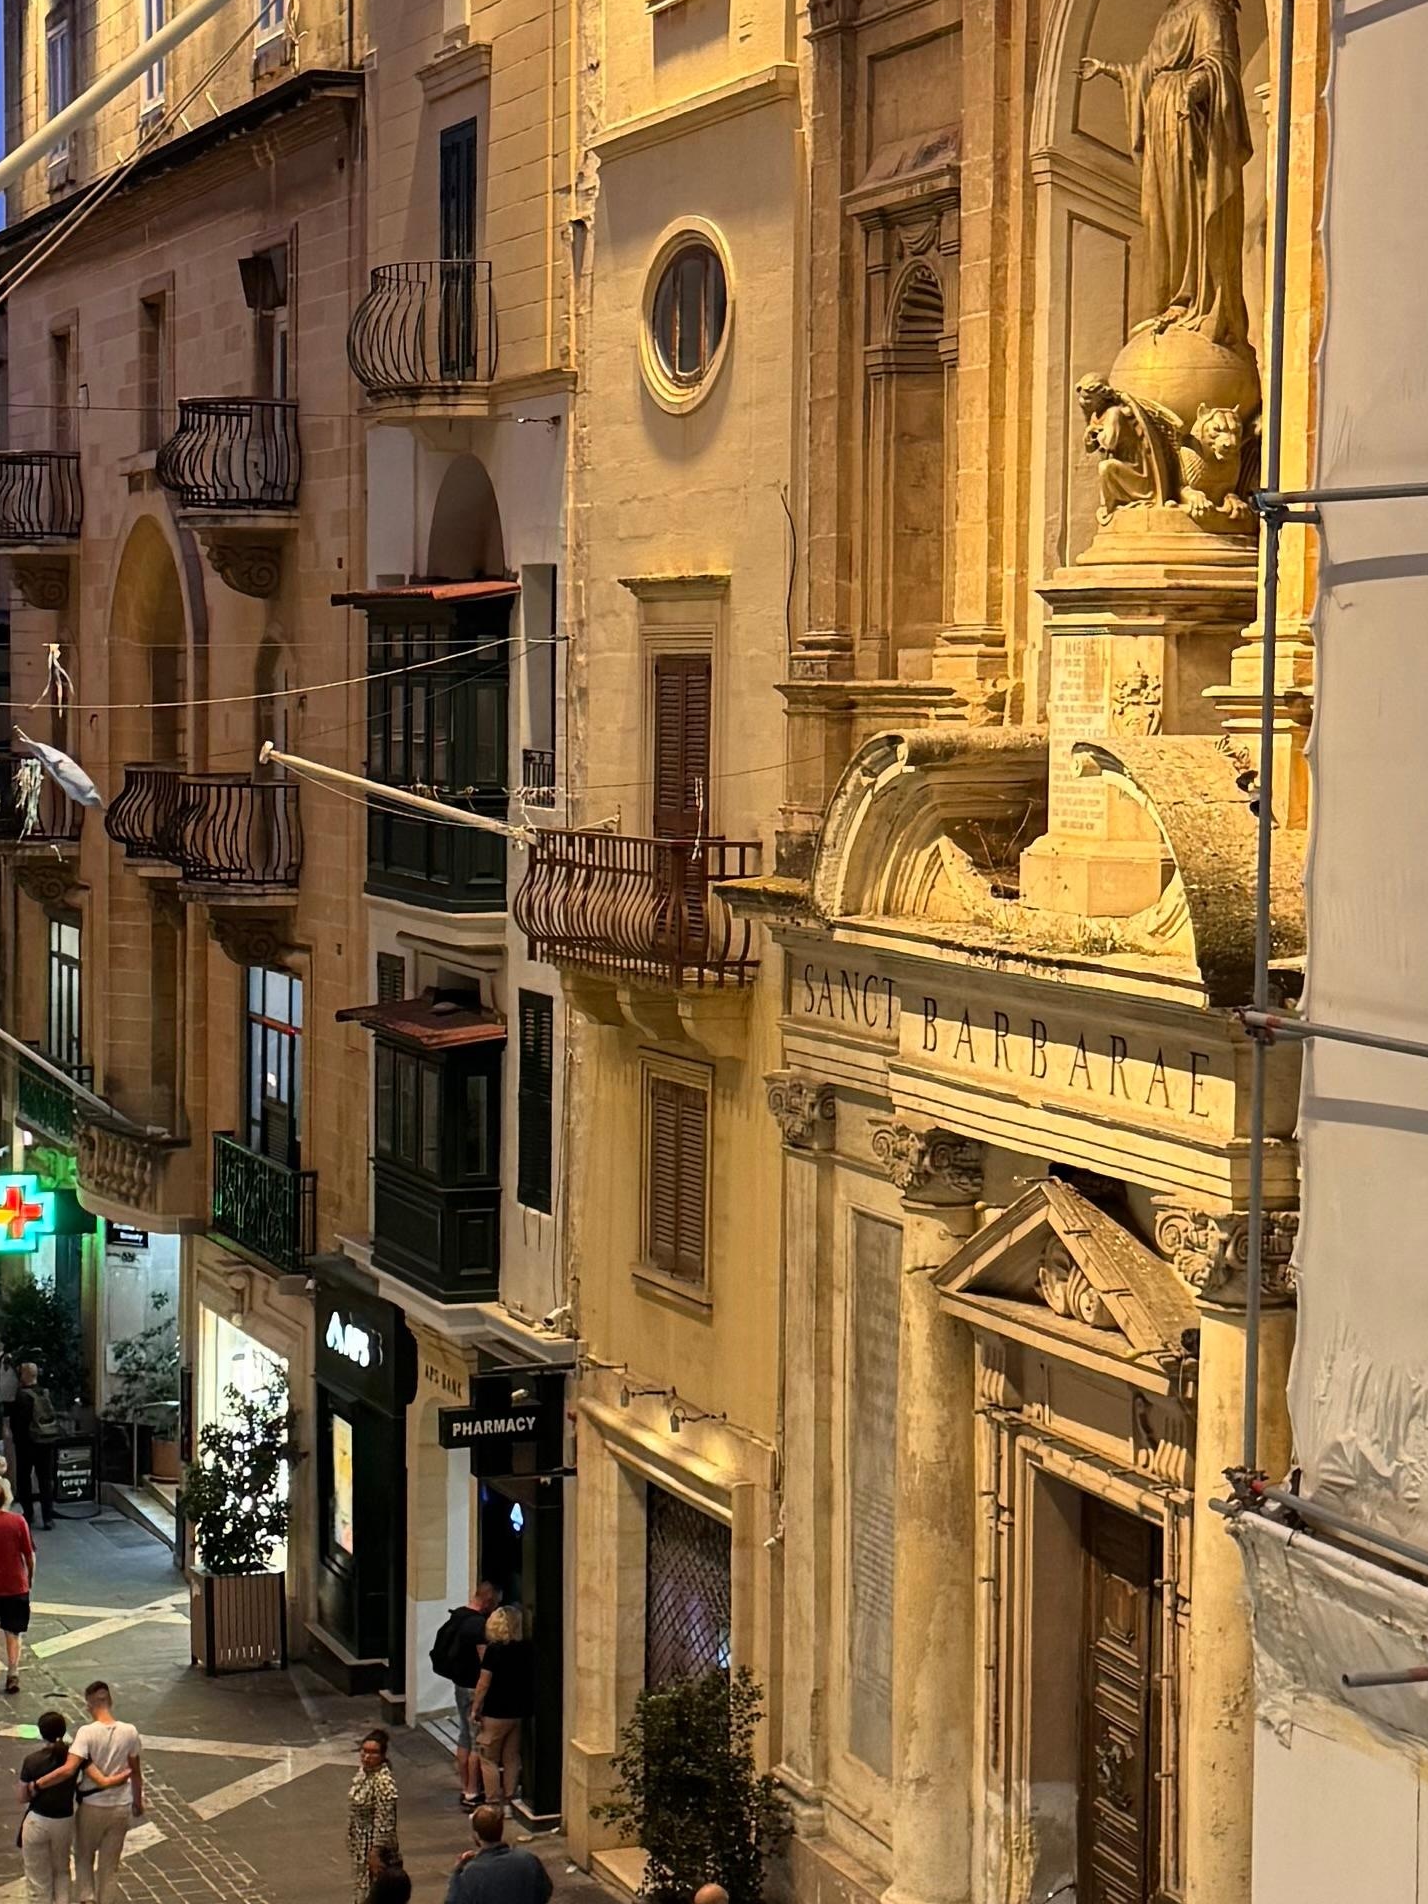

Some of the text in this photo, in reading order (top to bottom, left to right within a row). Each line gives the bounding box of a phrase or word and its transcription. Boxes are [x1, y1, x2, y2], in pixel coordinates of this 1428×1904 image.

[922, 996, 1210, 1118] BARBARAE
[442, 1374, 462, 1399] BANK
[452, 1416, 536, 1437] PHARMACY
